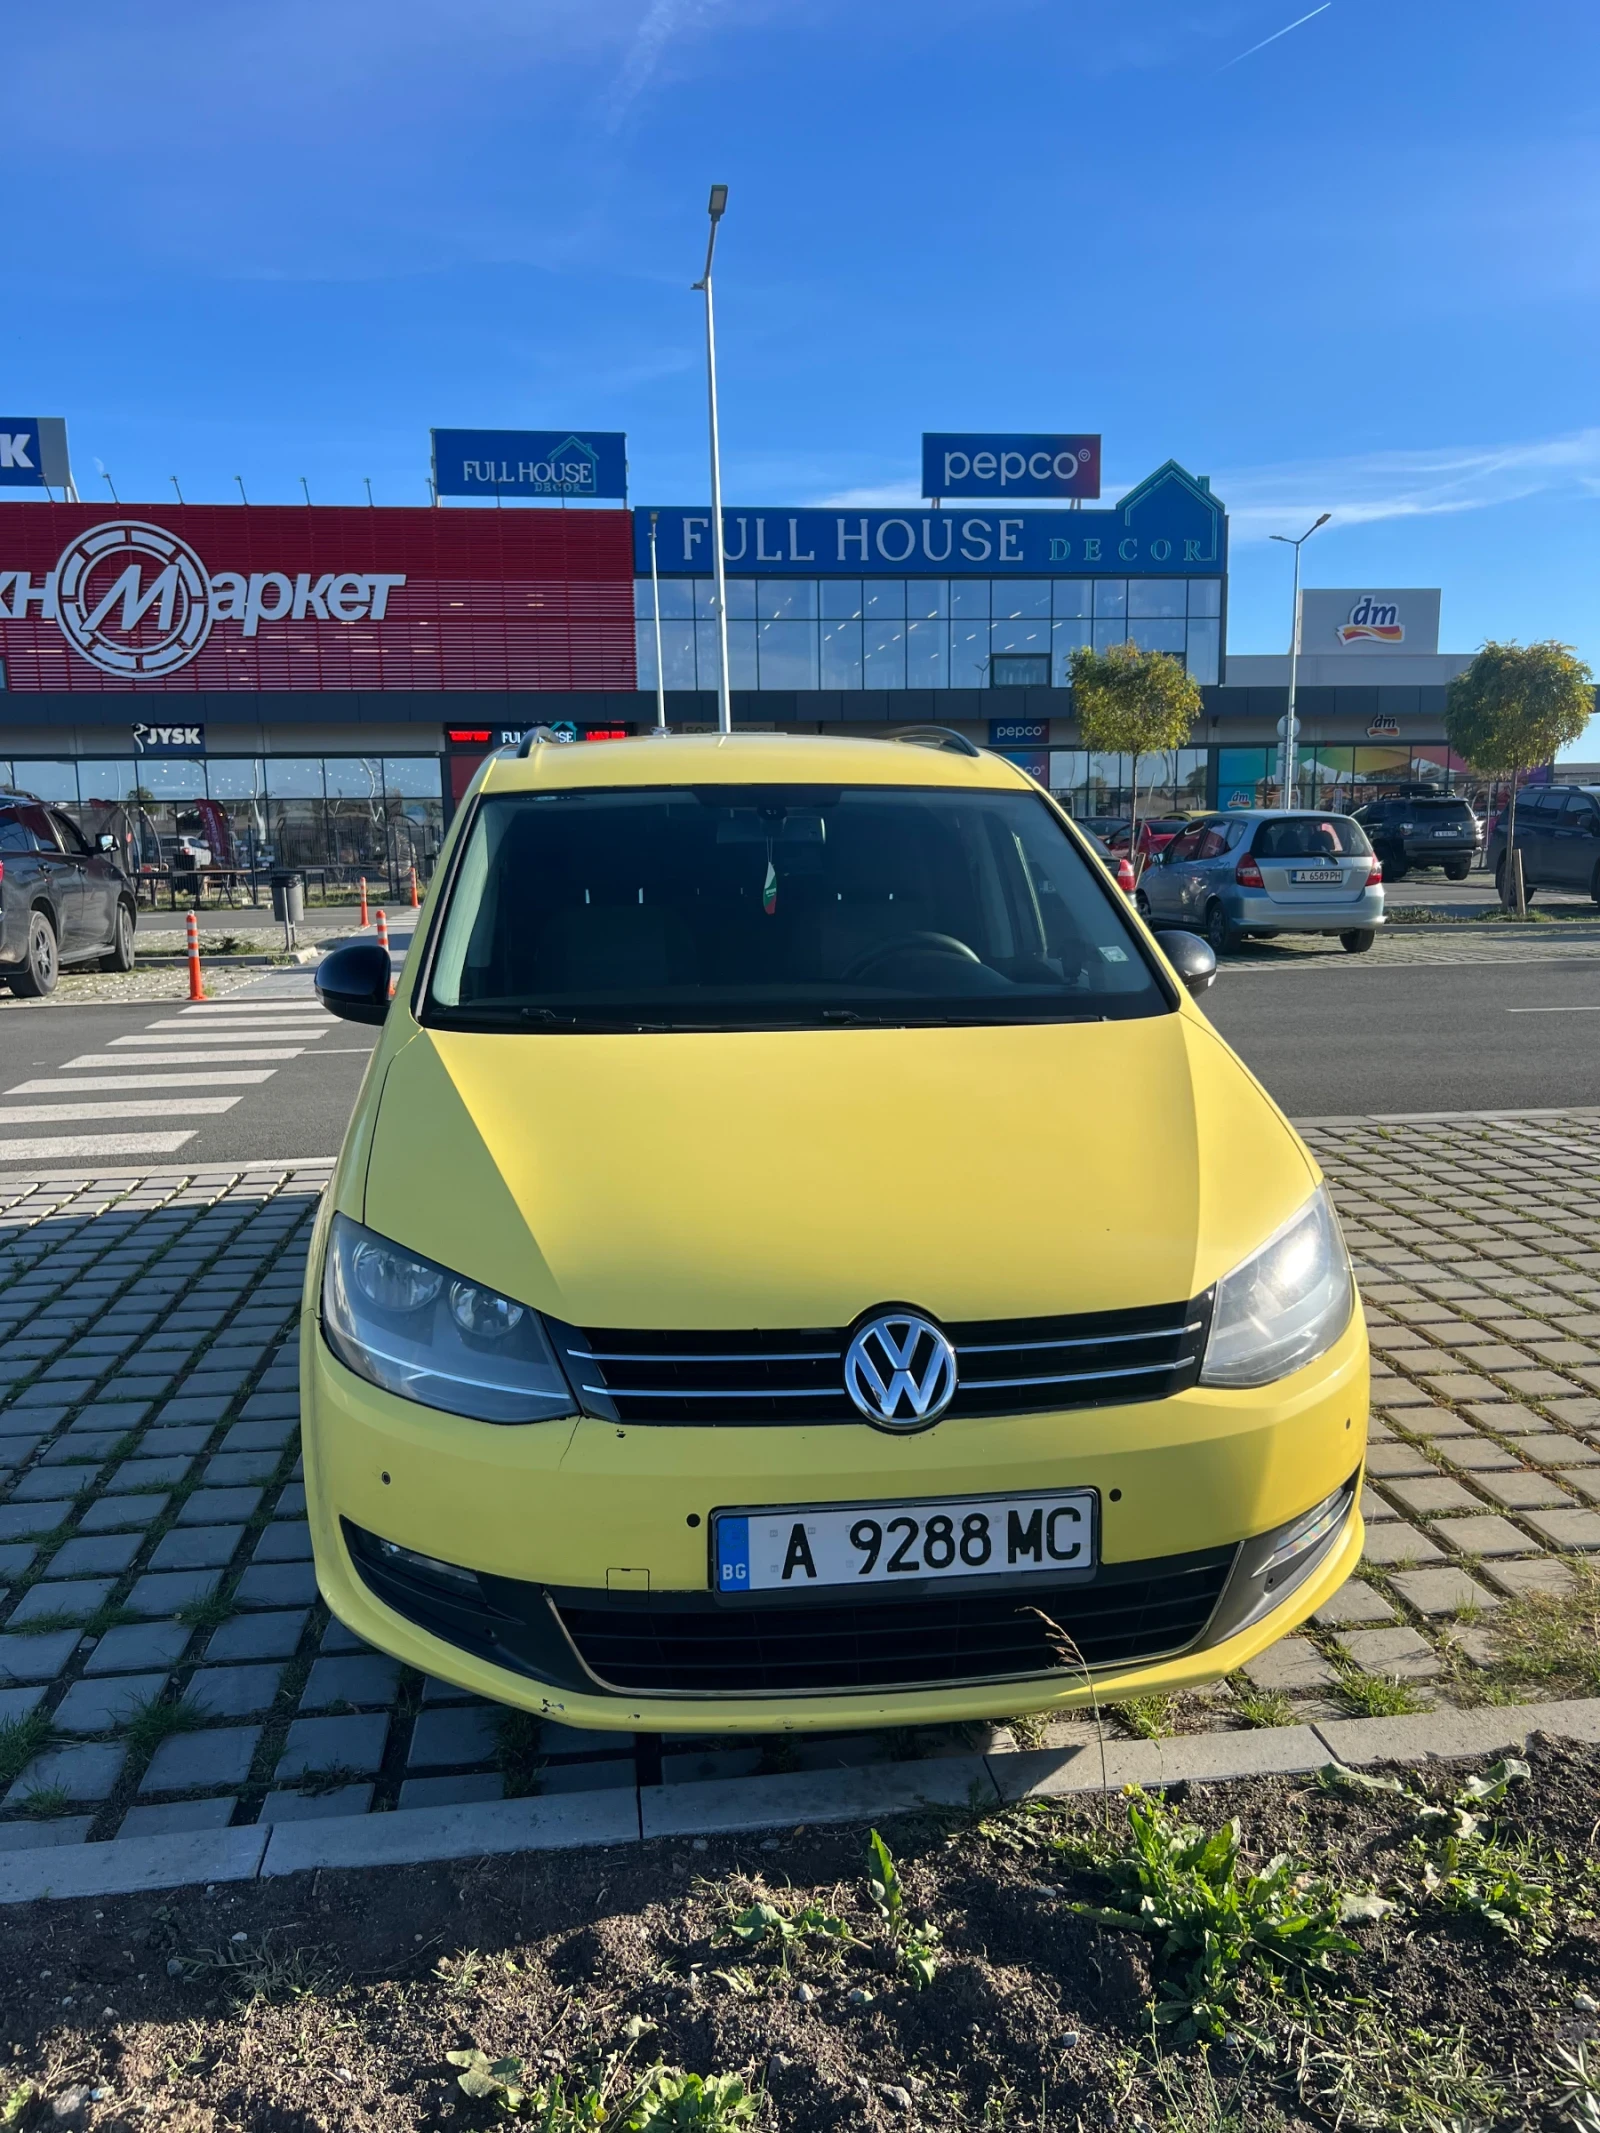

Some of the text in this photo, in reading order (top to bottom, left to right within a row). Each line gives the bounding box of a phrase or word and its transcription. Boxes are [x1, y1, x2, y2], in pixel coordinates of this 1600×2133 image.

[463, 460, 592, 483] FULL HOUSE
[944, 451, 1079, 487] pepco
[534, 482, 581, 493] DECOR
[682, 517, 1202, 562] FULL HOUSE DECOR
[1353, 597, 1398, 626] dm
[1374, 715, 1396, 728] dm
[147, 727, 201, 745] JYSK
[996, 726, 1042, 739] pepco
[1232, 791, 1249, 802] dm
[1300, 871, 1341, 880] A 6589 PH
[781, 1506, 1081, 1580] A 9288 MC
[722, 1563, 747, 1581] BG
